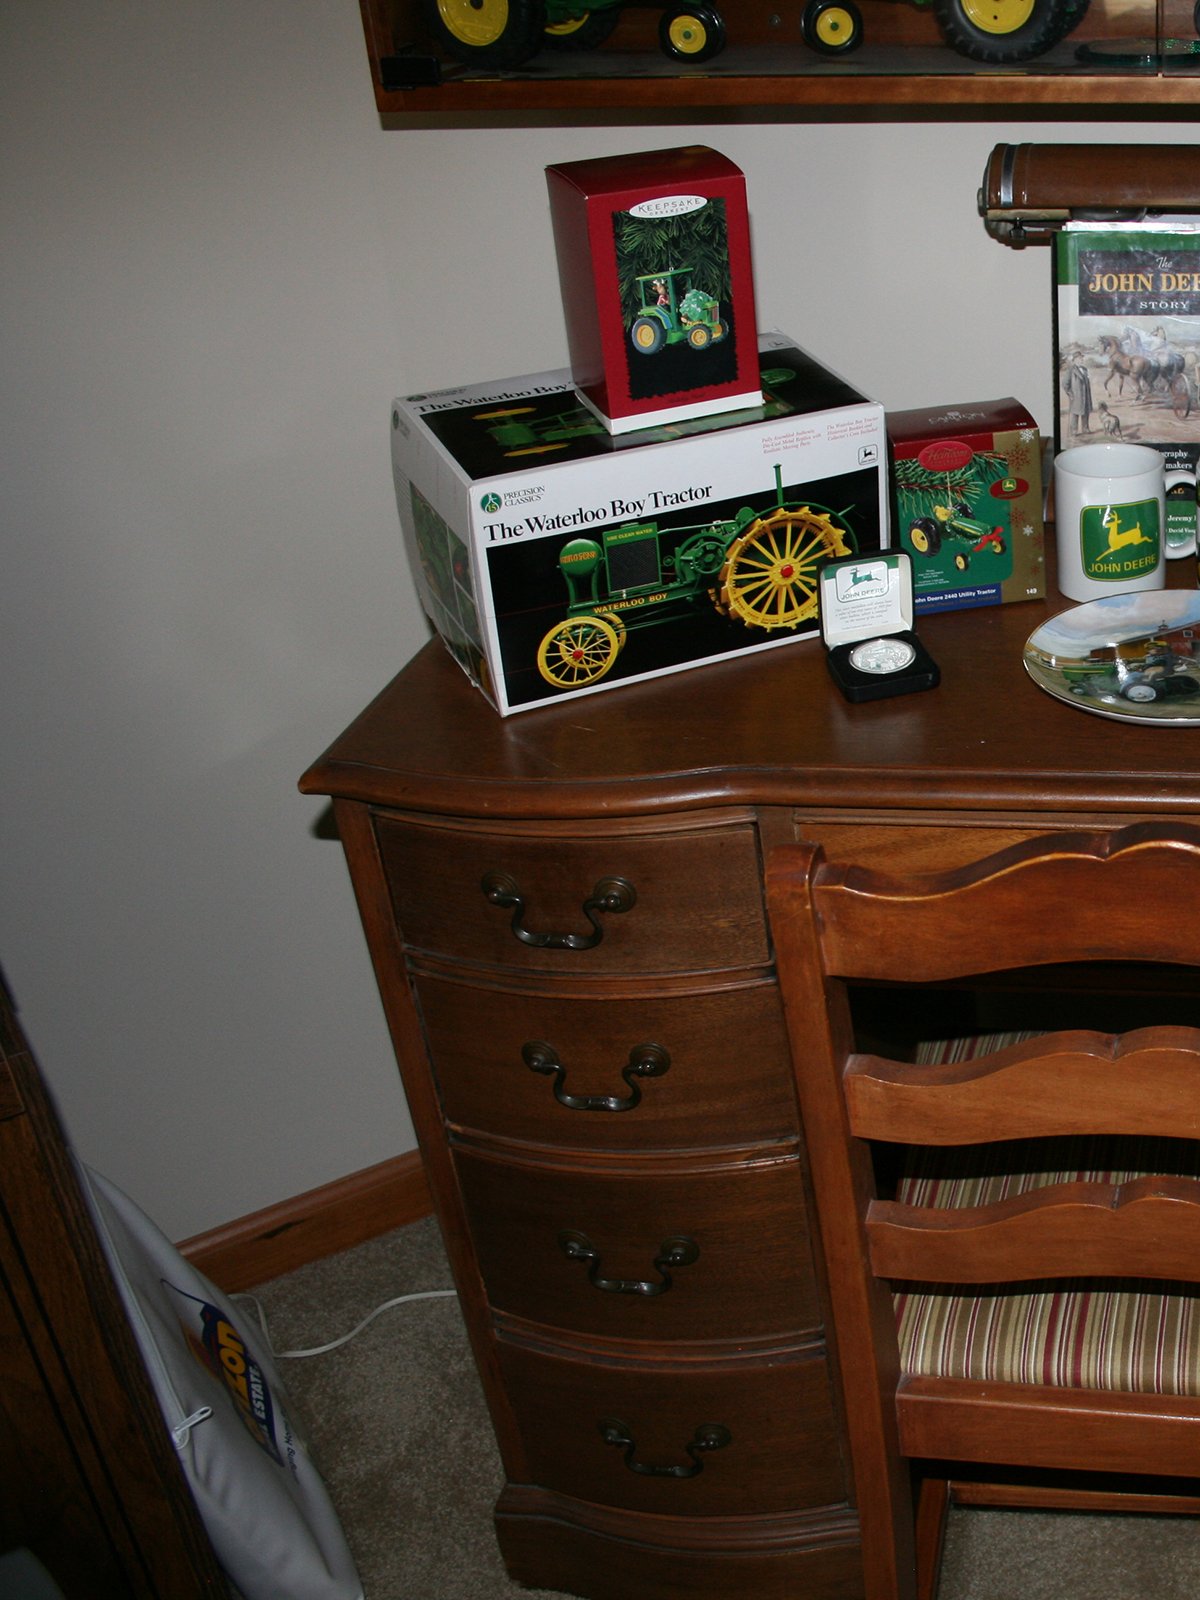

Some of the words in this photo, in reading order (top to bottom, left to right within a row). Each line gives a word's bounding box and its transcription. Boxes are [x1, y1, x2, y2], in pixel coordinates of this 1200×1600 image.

[638, 197, 701, 213] KEEPSAKE
[650, 206, 689, 216] ORNAMENT
[1156, 256, 1173, 269] The
[1088, 272, 1154, 293] JOHN
[1139, 301, 1190, 309] STORY
[413, 403, 451, 413] The
[453, 389, 532, 406] Waterloo
[533, 383, 569, 394] Boy
[1165, 461, 1192, 469] makers
[503, 485, 546, 500] PRECISION
[504, 494, 541, 508] CLASSICS
[483, 523, 524, 542] The
[524, 506, 607, 534] Waterloo
[610, 498, 646, 523] Boy
[648, 485, 713, 509] Tractor
[1167, 514, 1192, 522] Jeremy
[1088, 561, 1121, 573] JOHN
[1123, 554, 1157, 571] DEERE
[841, 592, 860, 600] JOHN
[958, 591, 976, 599] Utility
[976, 588, 997, 596] Tractor
[593, 598, 645, 614] WATERLOO
[649, 592, 668, 603] BOY
